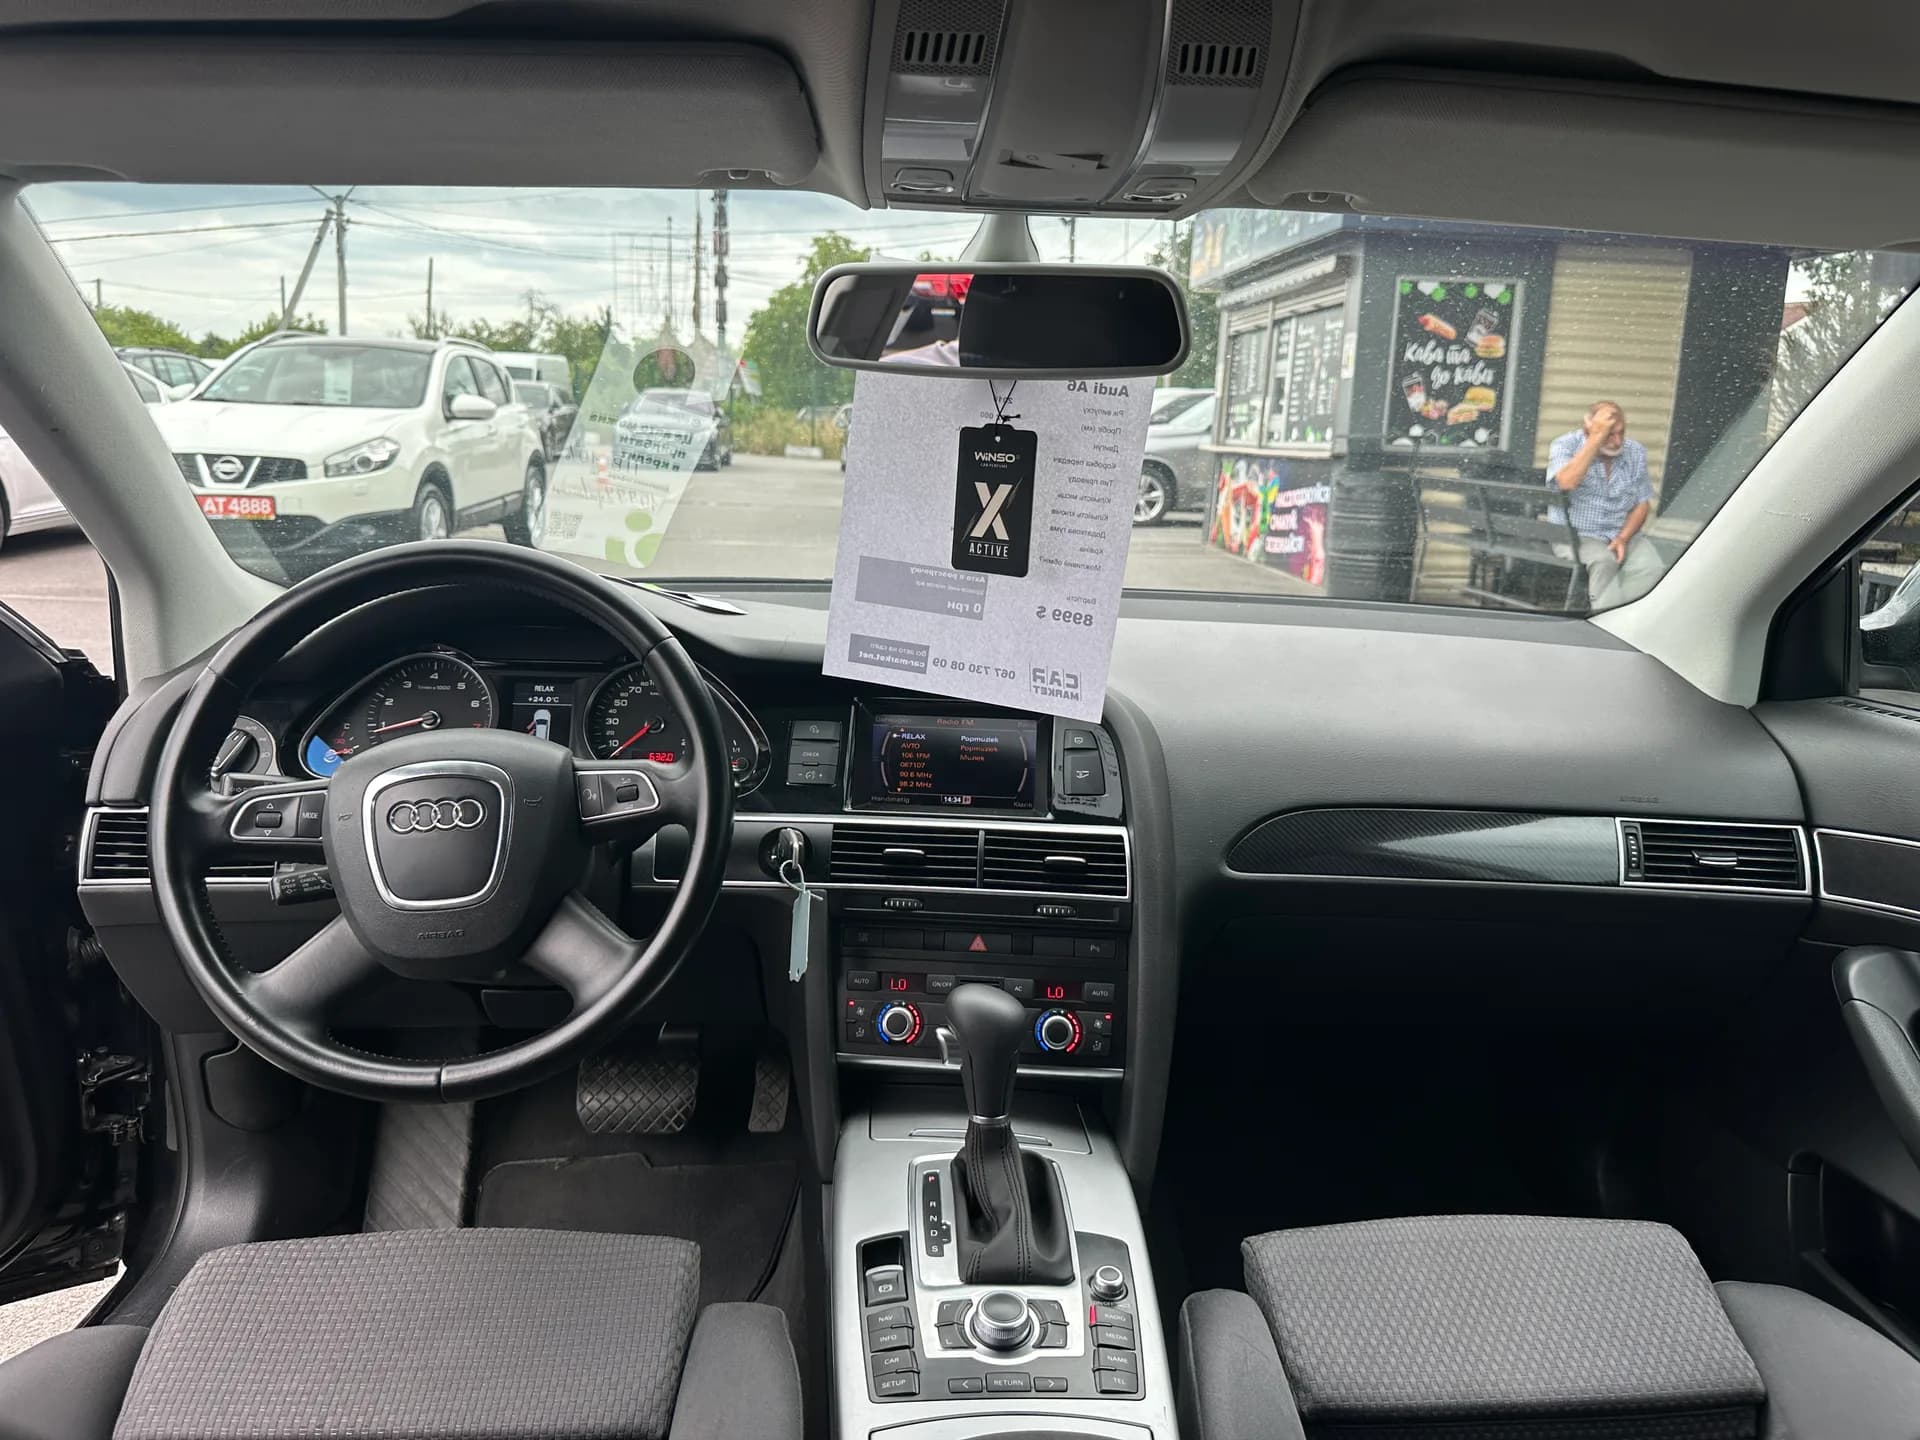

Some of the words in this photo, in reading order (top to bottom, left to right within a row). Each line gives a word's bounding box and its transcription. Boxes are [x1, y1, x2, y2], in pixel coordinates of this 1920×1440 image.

[227, 497, 271, 514] 4888
[970, 482, 1015, 540] X
[969, 542, 1009, 557] ACTIVE
[402, 680, 412, 688] 3
[456, 682, 466, 690] 5
[628, 686, 642, 694] 70
[385, 698, 394, 706] 2
[470, 700, 480, 708] 6
[901, 733, 926, 741] RELAX
[960, 735, 999, 743] Popmuziek
[609, 739, 619, 747] 10
[416, 929, 465, 940] AIRBAG
[878, 1314, 893, 1322] NAV
[1104, 1313, 1127, 1321] RADIO
[879, 1334, 897, 1342] INFO
[884, 1356, 900, 1365] CAR
[1107, 1355, 1128, 1363] NAME
[881, 1379, 906, 1389] SETUP
[1113, 1376, 1126, 1385] TEL
